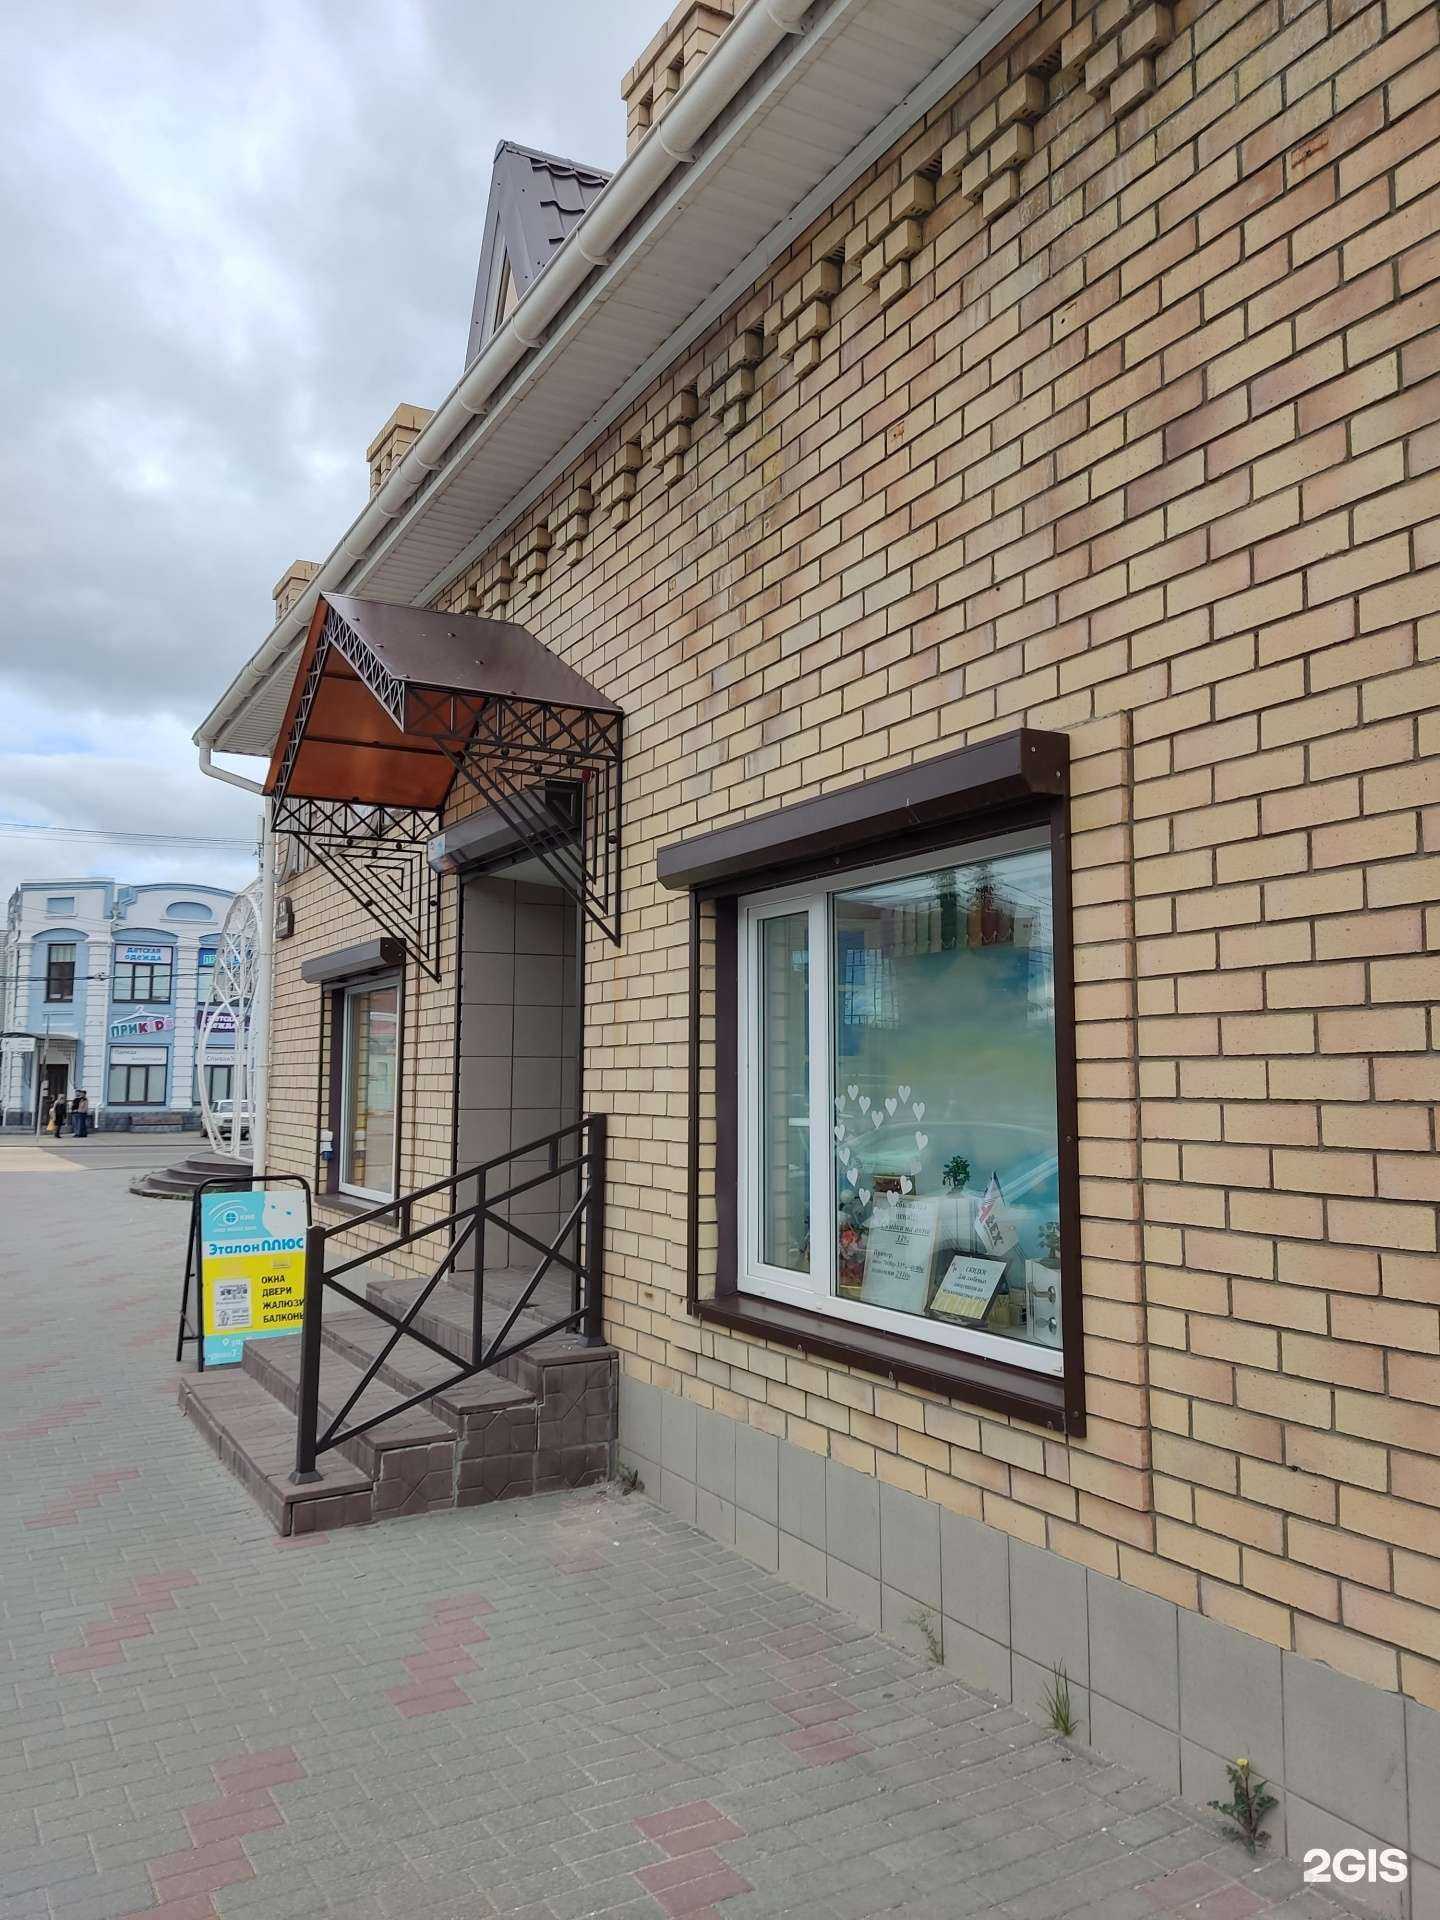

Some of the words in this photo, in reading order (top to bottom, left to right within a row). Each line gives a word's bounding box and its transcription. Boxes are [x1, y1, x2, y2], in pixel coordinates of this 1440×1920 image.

[261, 1275, 285, 1284] ОКНА
[262, 1287, 292, 1297] ДВЕРИ
[263, 1299, 304, 1309] ЖАЛЮЗИ
